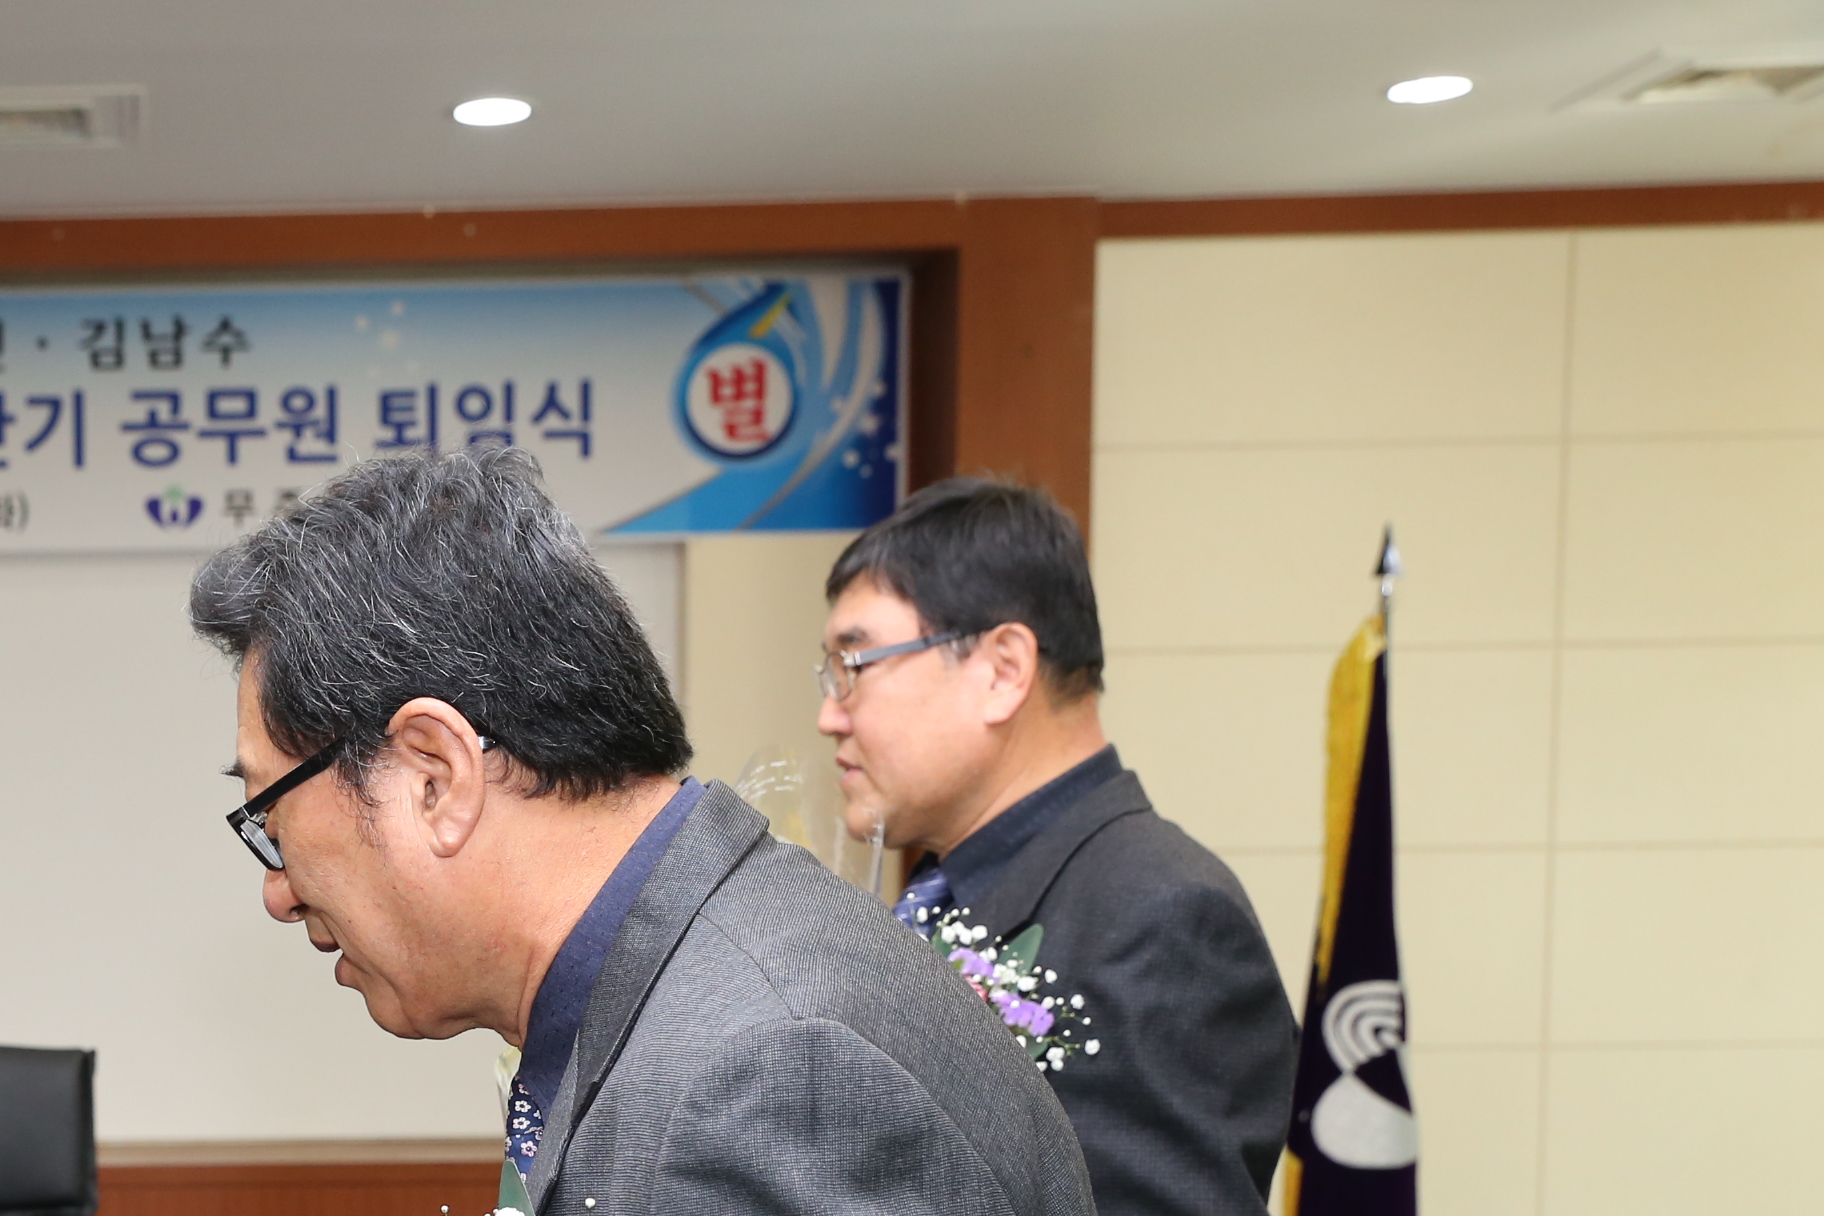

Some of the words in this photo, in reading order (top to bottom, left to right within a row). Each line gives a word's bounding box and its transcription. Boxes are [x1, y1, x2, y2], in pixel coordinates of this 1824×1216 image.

[79, 314, 251, 371] 김남수
[120, 382, 339, 468] 공무원
[372, 376, 594, 459] 퇴임식
[707, 358, 771, 443] 별
